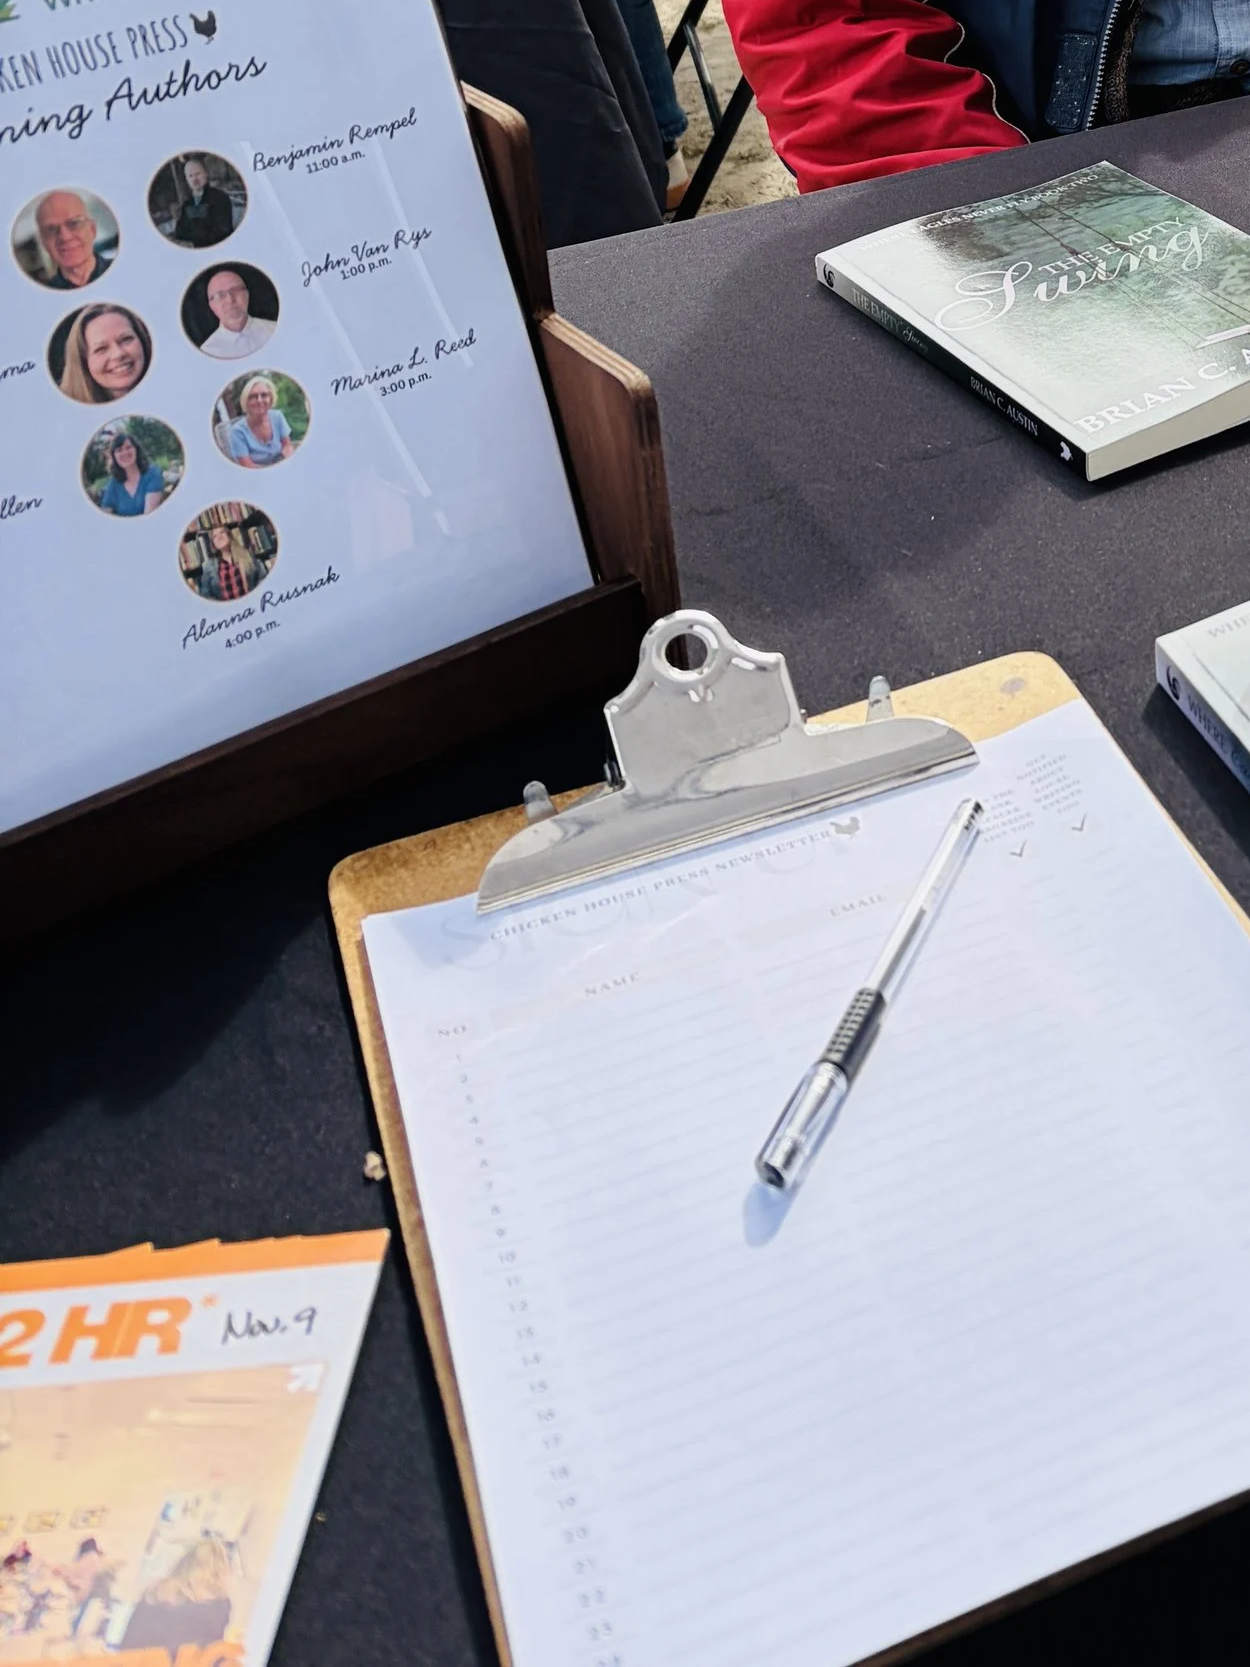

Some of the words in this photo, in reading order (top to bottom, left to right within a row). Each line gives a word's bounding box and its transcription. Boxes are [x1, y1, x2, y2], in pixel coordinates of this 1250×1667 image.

[46, 31, 122, 79] HOUSE
[126, 15, 189, 60] PRESS
[105, 56, 268, 122] Authors
[252, 136, 343, 173] Benjamin
[348, 107, 417, 145] Rempel
[305, 155, 338, 174] 11:00
[341, 149, 366, 165] a.m.
[301, 253, 350, 287] John
[351, 240, 389, 262] Van
[394, 227, 433, 250] Rys
[340, 263, 366, 280] 1:00
[368, 256, 392, 274] p.m.
[1039, 251, 1100, 275] THE
[1096, 217, 1186, 256] EMPTY
[934, 226, 1210, 331] Swing
[851, 287, 870, 311] THE
[869, 299, 903, 332] EMPTY
[330, 361, 405, 397] Marina
[434, 328, 477, 360] Reed
[380, 379, 406, 397] 3:00
[409, 371, 433, 391] p.m.
[969, 376, 996, 404] BRIAN
[1006, 404, 1039, 436] AUSTIN
[1073, 375, 1196, 434] BRIAN
[1198, 362, 1237, 381] C.
[182, 606, 255, 650] Alanna
[260, 565, 341, 613] Rusnak
[225, 629, 253, 649] 4:00
[255, 620, 281, 639] p.m.
[488, 907, 577, 942] CHICKEN
[583, 885, 649, 913] HOUSE
[654, 867, 710, 893] PRESS
[715, 829, 833, 874] NEWSLETTER
[829, 892, 888, 920] EMAIL
[584, 971, 641, 998] NAME
[293, 1306, 318, 1336] 9
